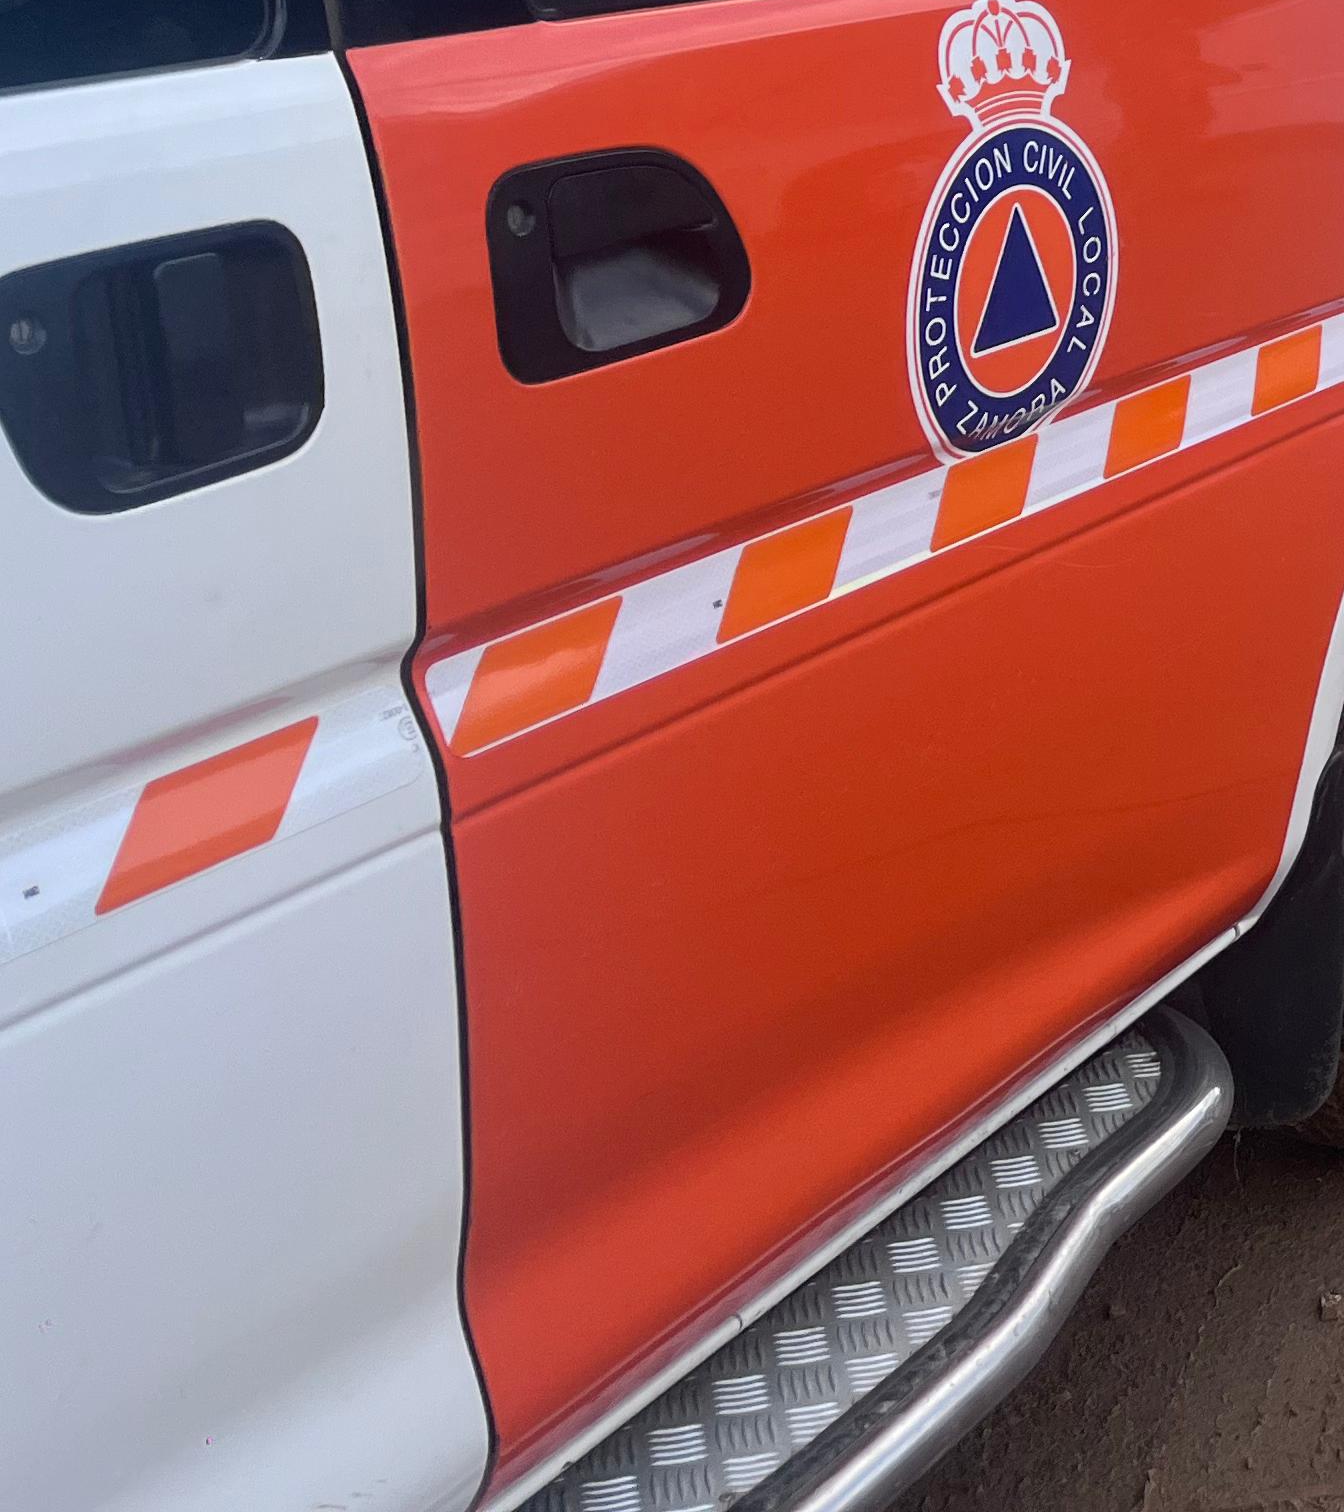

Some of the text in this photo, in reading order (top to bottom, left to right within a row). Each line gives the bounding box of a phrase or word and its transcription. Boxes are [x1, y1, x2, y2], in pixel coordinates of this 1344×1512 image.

[925, 139, 1101, 407] PROTECCION CIVIL LOCAL
[955, 376, 1067, 441] ZAMORA
